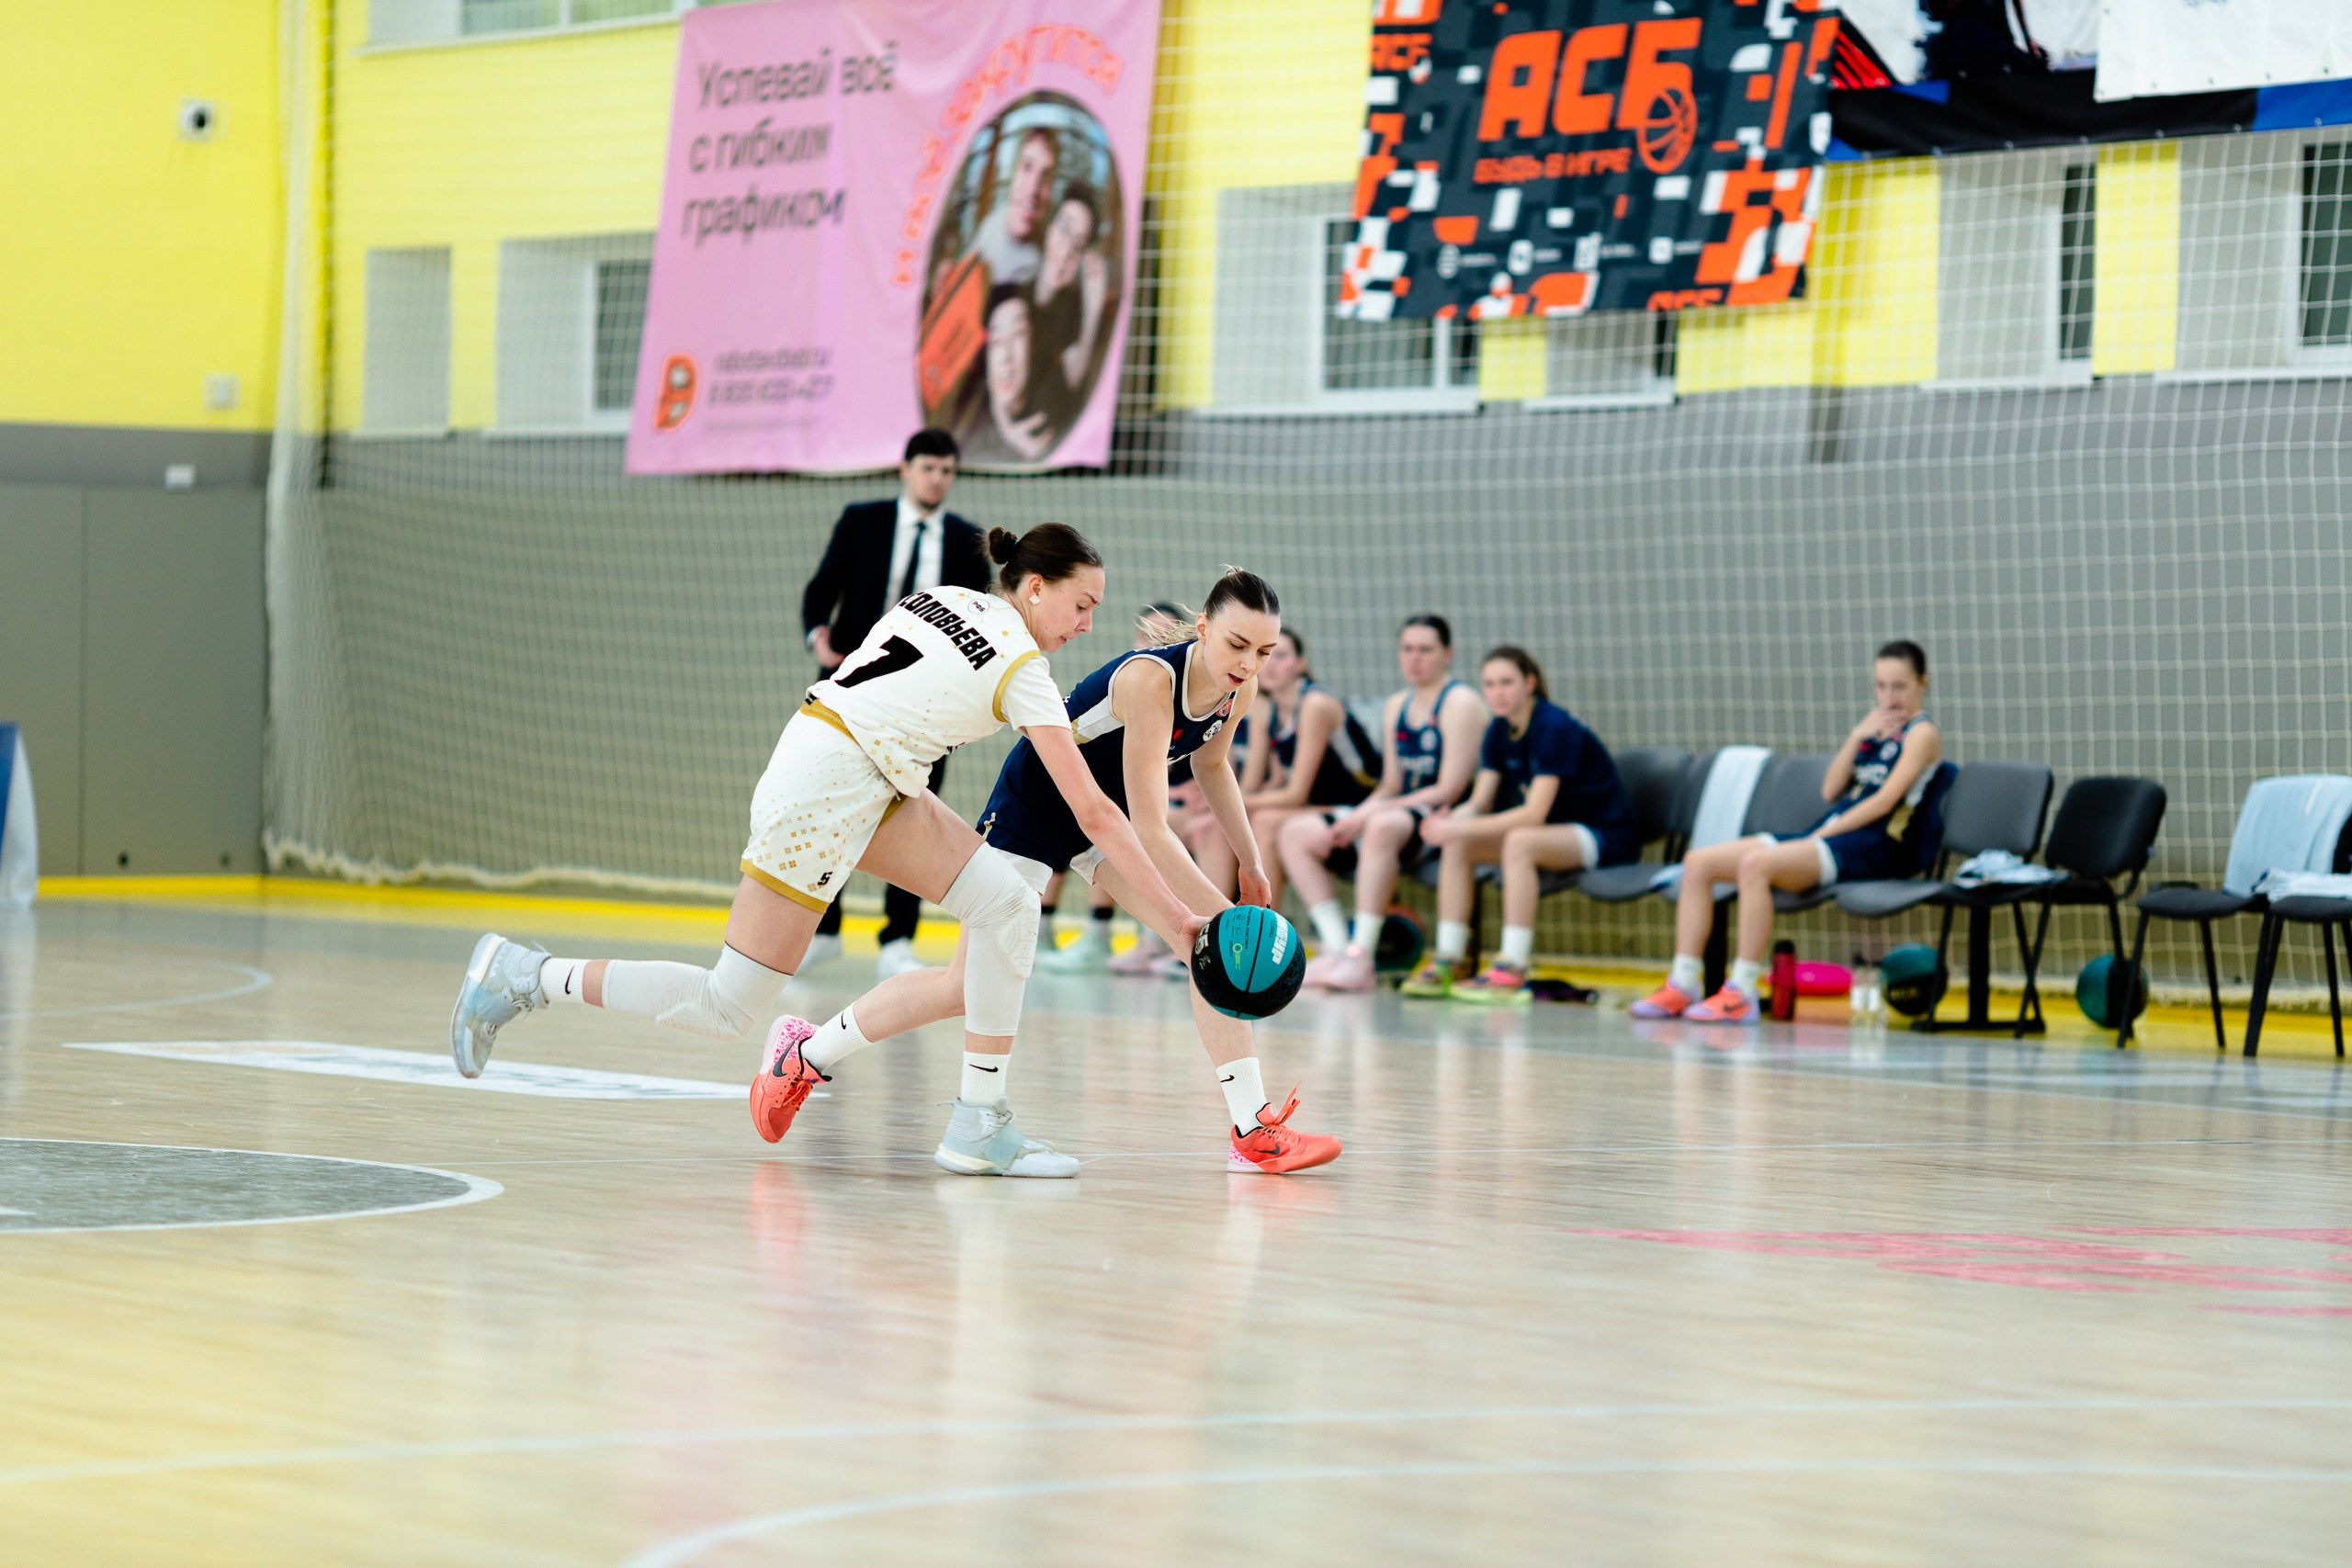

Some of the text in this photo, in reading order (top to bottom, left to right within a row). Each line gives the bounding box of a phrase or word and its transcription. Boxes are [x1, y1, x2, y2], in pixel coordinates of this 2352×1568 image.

[697, 40, 898, 110] Успевай всё
[1477, 17, 1702, 141] АСБ
[689, 116, 832, 174] с гибким
[681, 184, 846, 250] графиком
[833, 634, 924, 689] 7
